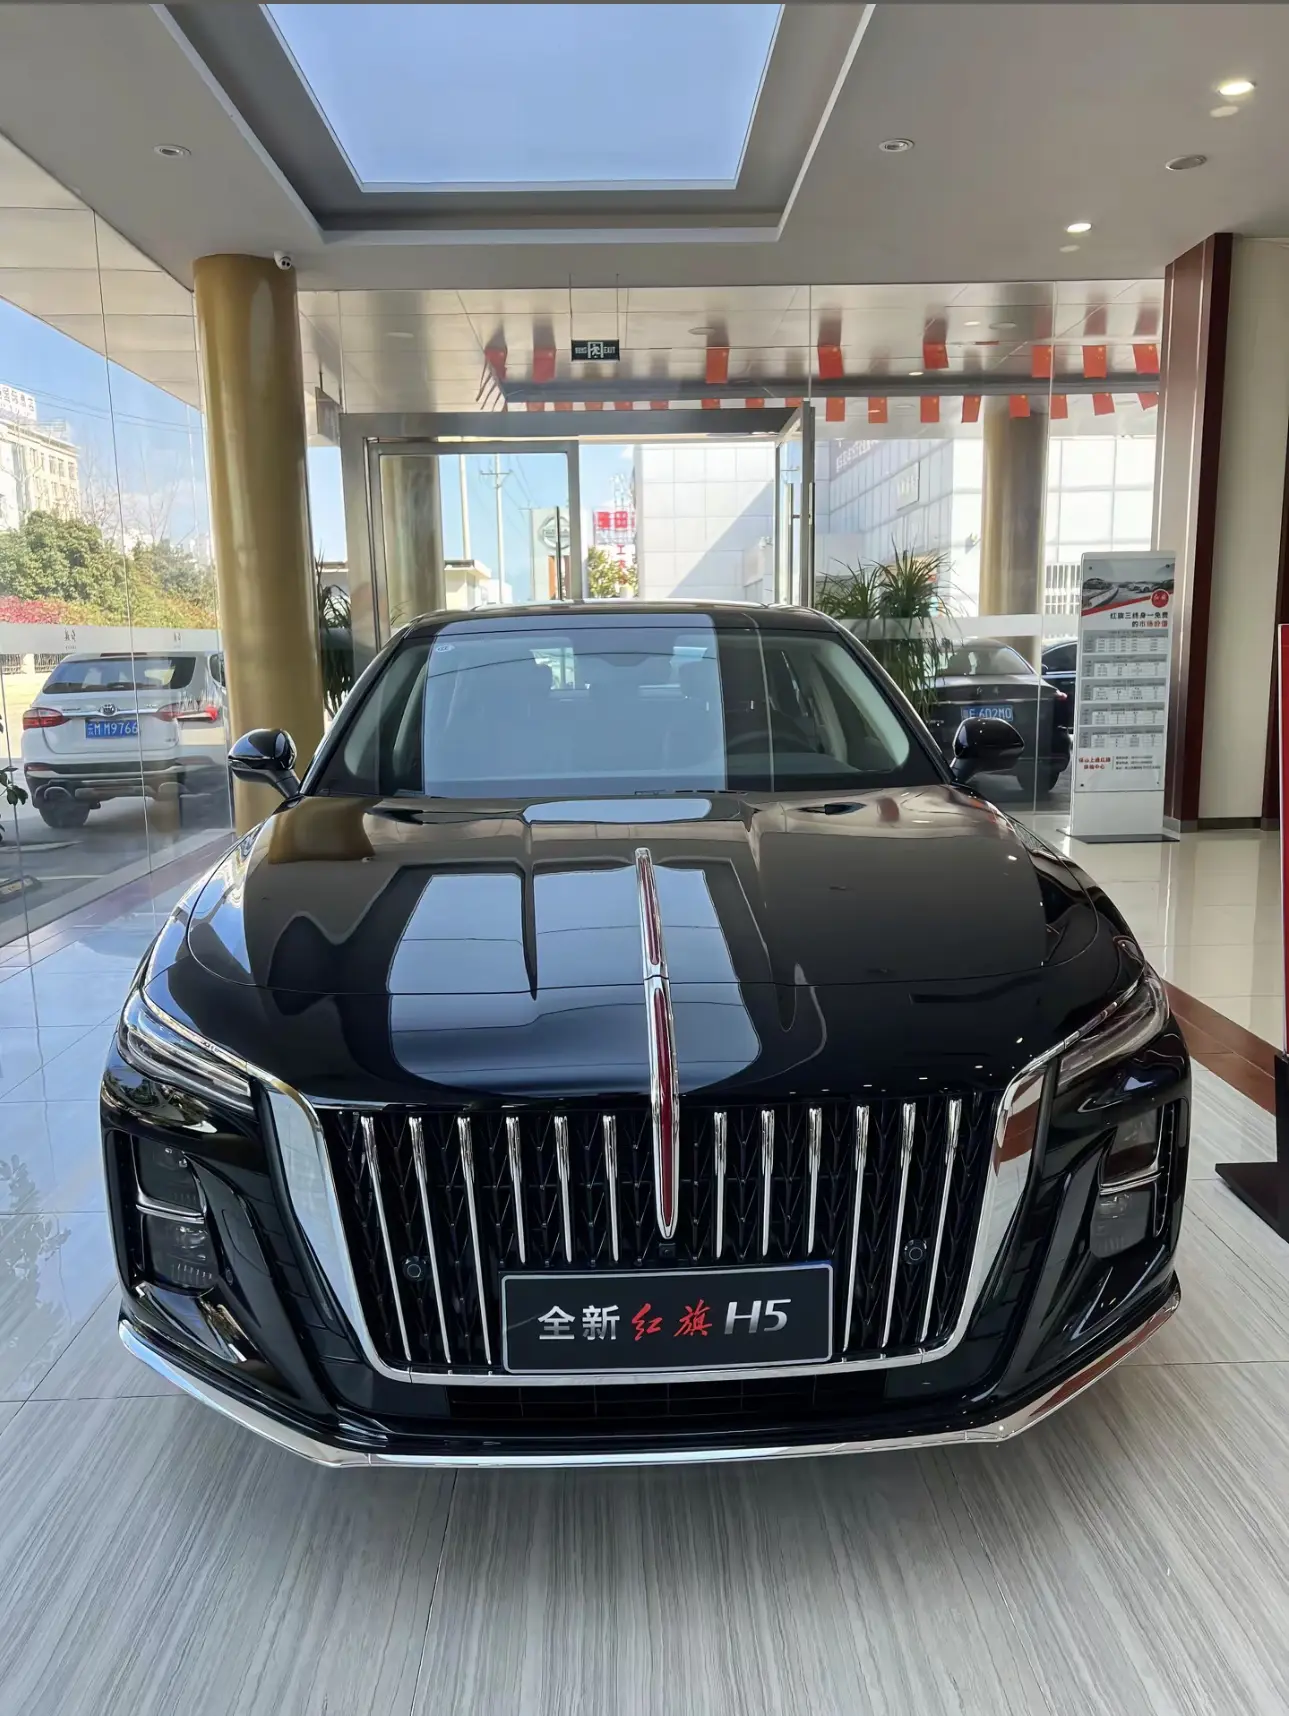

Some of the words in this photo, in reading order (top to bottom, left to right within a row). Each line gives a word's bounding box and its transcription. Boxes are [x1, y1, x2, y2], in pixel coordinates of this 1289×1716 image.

[537, 1304, 621, 1341] 全新
[631, 1299, 712, 1341] 红旗
[724, 1298, 793, 1336] H5
